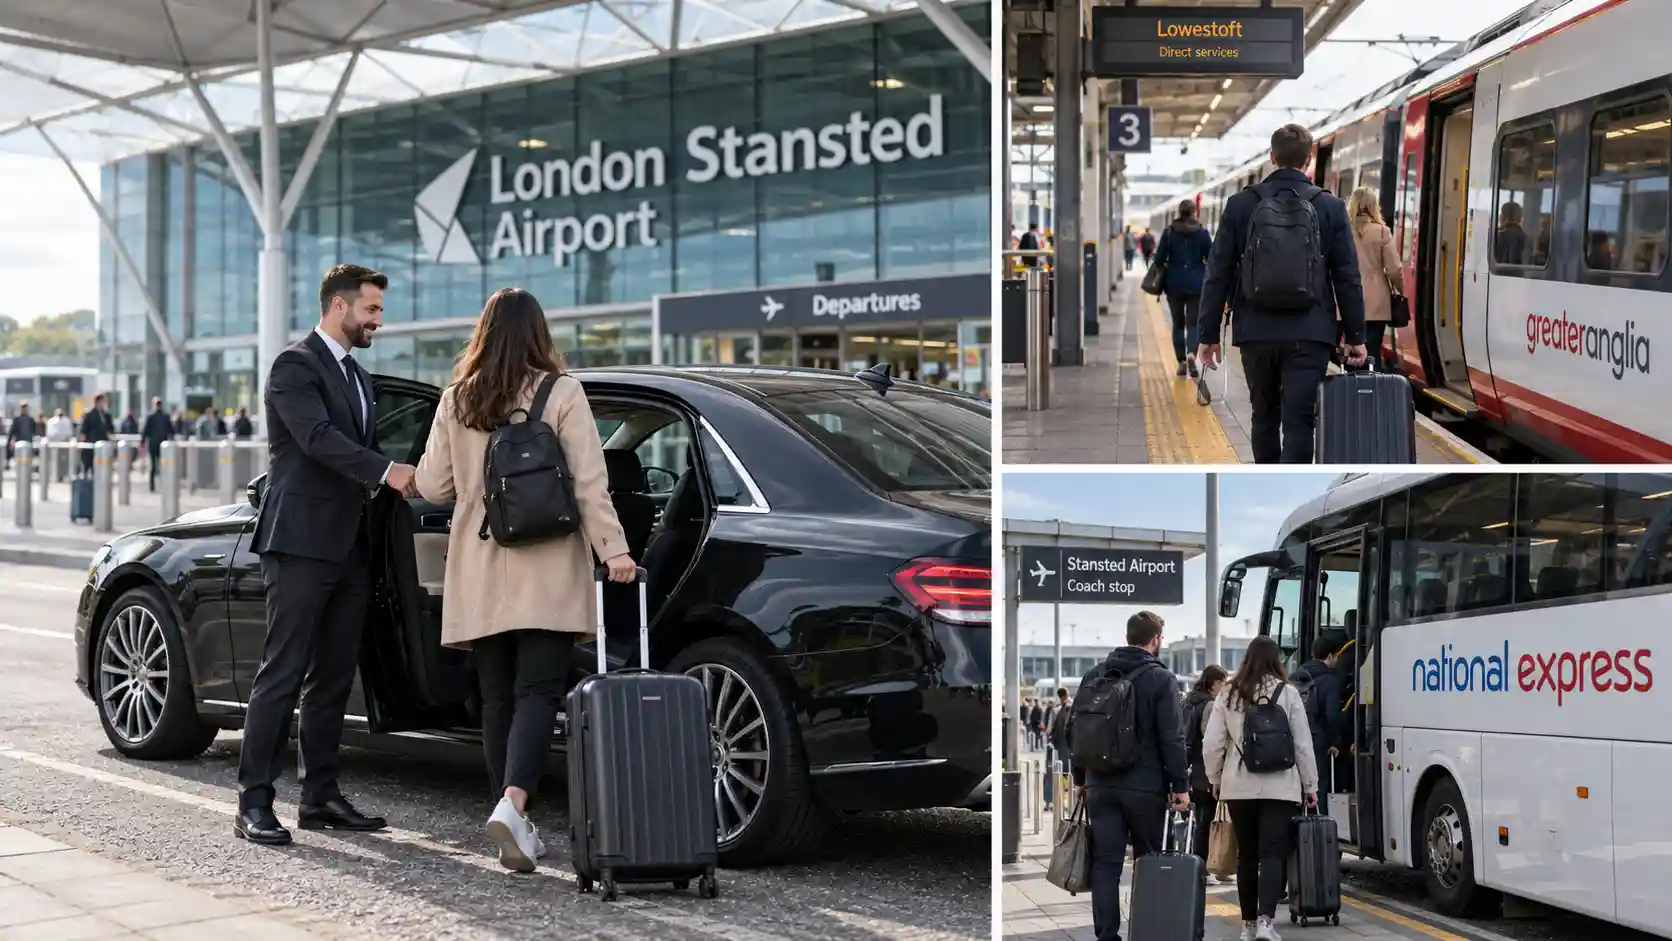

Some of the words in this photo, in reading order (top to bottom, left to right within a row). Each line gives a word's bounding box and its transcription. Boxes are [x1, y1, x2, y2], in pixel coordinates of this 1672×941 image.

[1157, 20, 1243, 37] Lowestoft
[1159, 46, 1192, 57] Direct
[1195, 46, 1239, 57] services
[1119, 113, 1140, 146] 3
[490, 140, 665, 204] London
[686, 94, 944, 183] Stansted
[489, 201, 657, 267] Airport
[813, 292, 921, 319] Departures
[1067, 556, 1126, 573] Stansted
[1129, 558, 1176, 575] Airport
[1067, 578, 1105, 593] Coach
[1108, 582, 1135, 596] stop
[1412, 639, 1509, 692] national
[1517, 648, 1653, 707] express
